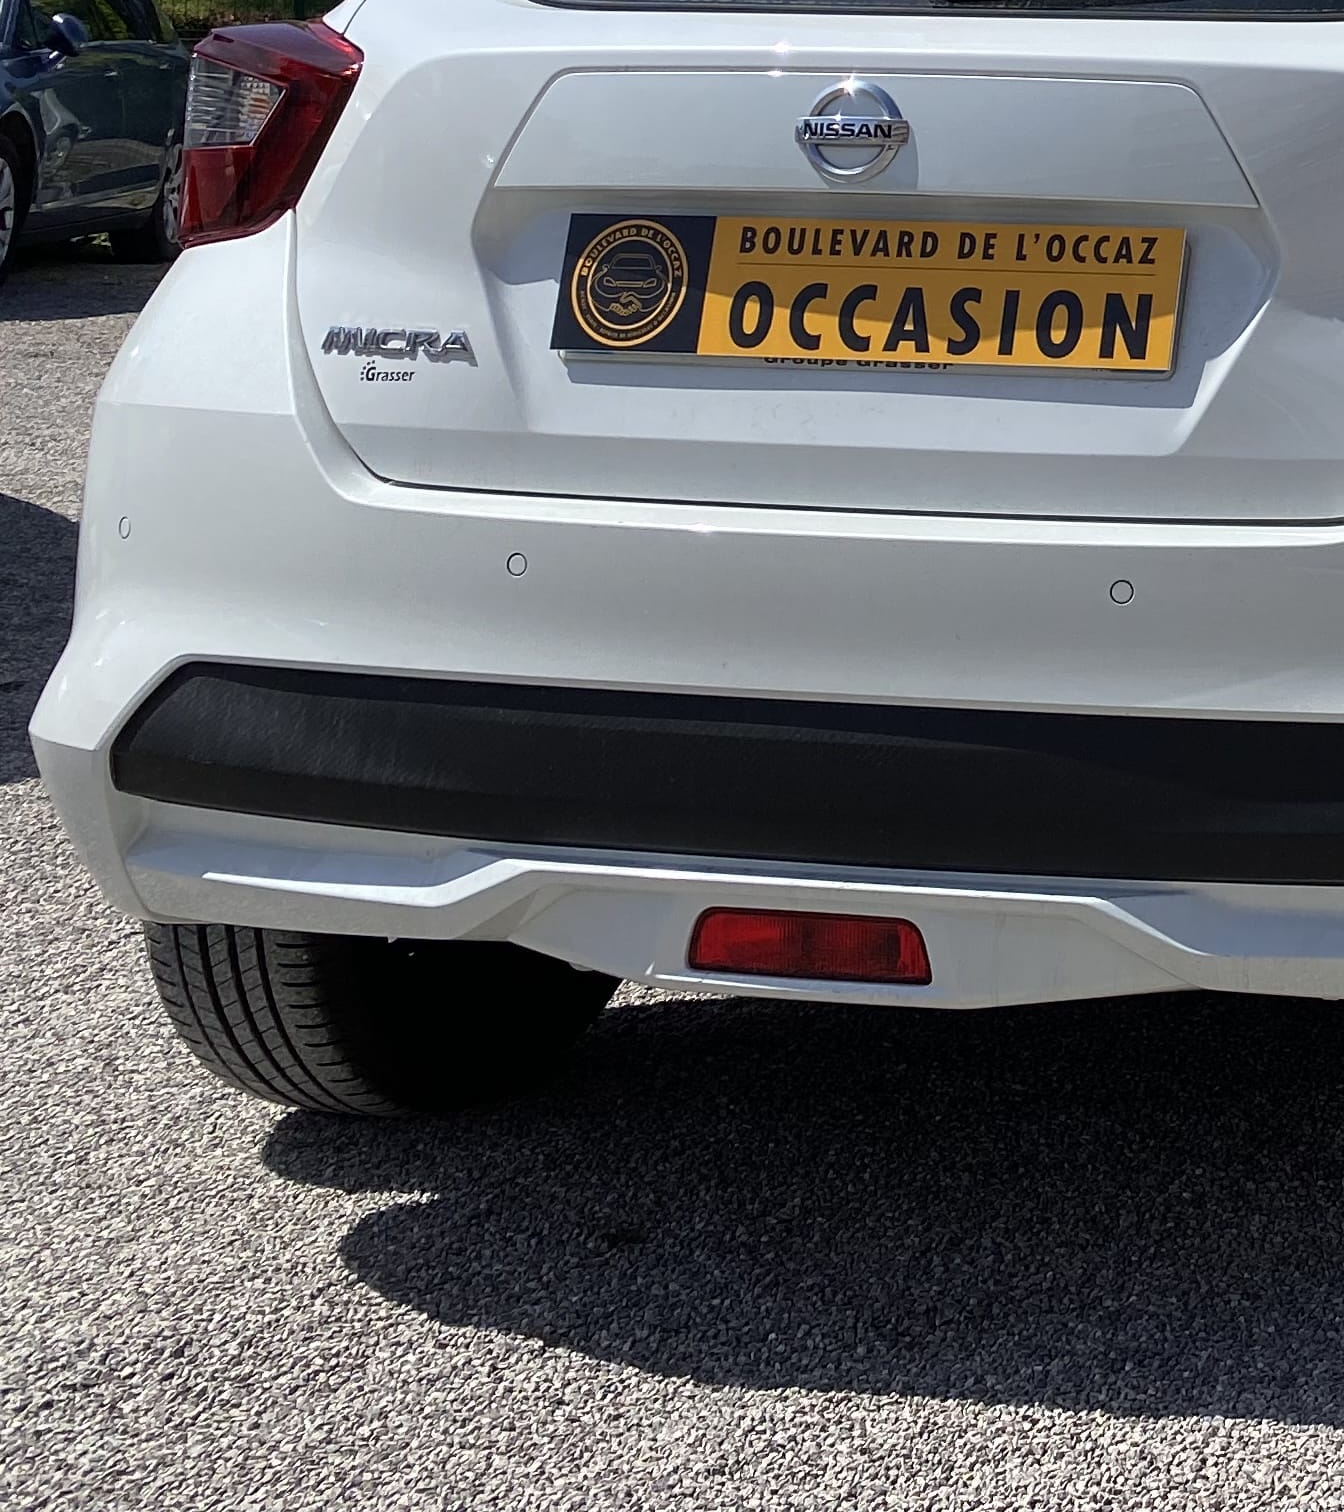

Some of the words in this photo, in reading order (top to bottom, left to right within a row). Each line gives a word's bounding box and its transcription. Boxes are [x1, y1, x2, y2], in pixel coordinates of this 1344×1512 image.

[803, 121, 894, 139] NISSAN
[580, 228, 637, 276] BOULEVARD
[641, 228, 654, 238] DE
[656, 233, 683, 278] L'OCCAZ
[739, 226, 940, 259] BOULEVARD
[957, 232, 997, 260] DE
[1015, 232, 1160, 265] L'OCCAZ
[727, 280, 1154, 360] OCCASION
[321, 326, 477, 365] MICRA
[364, 365, 416, 382] Grasser
